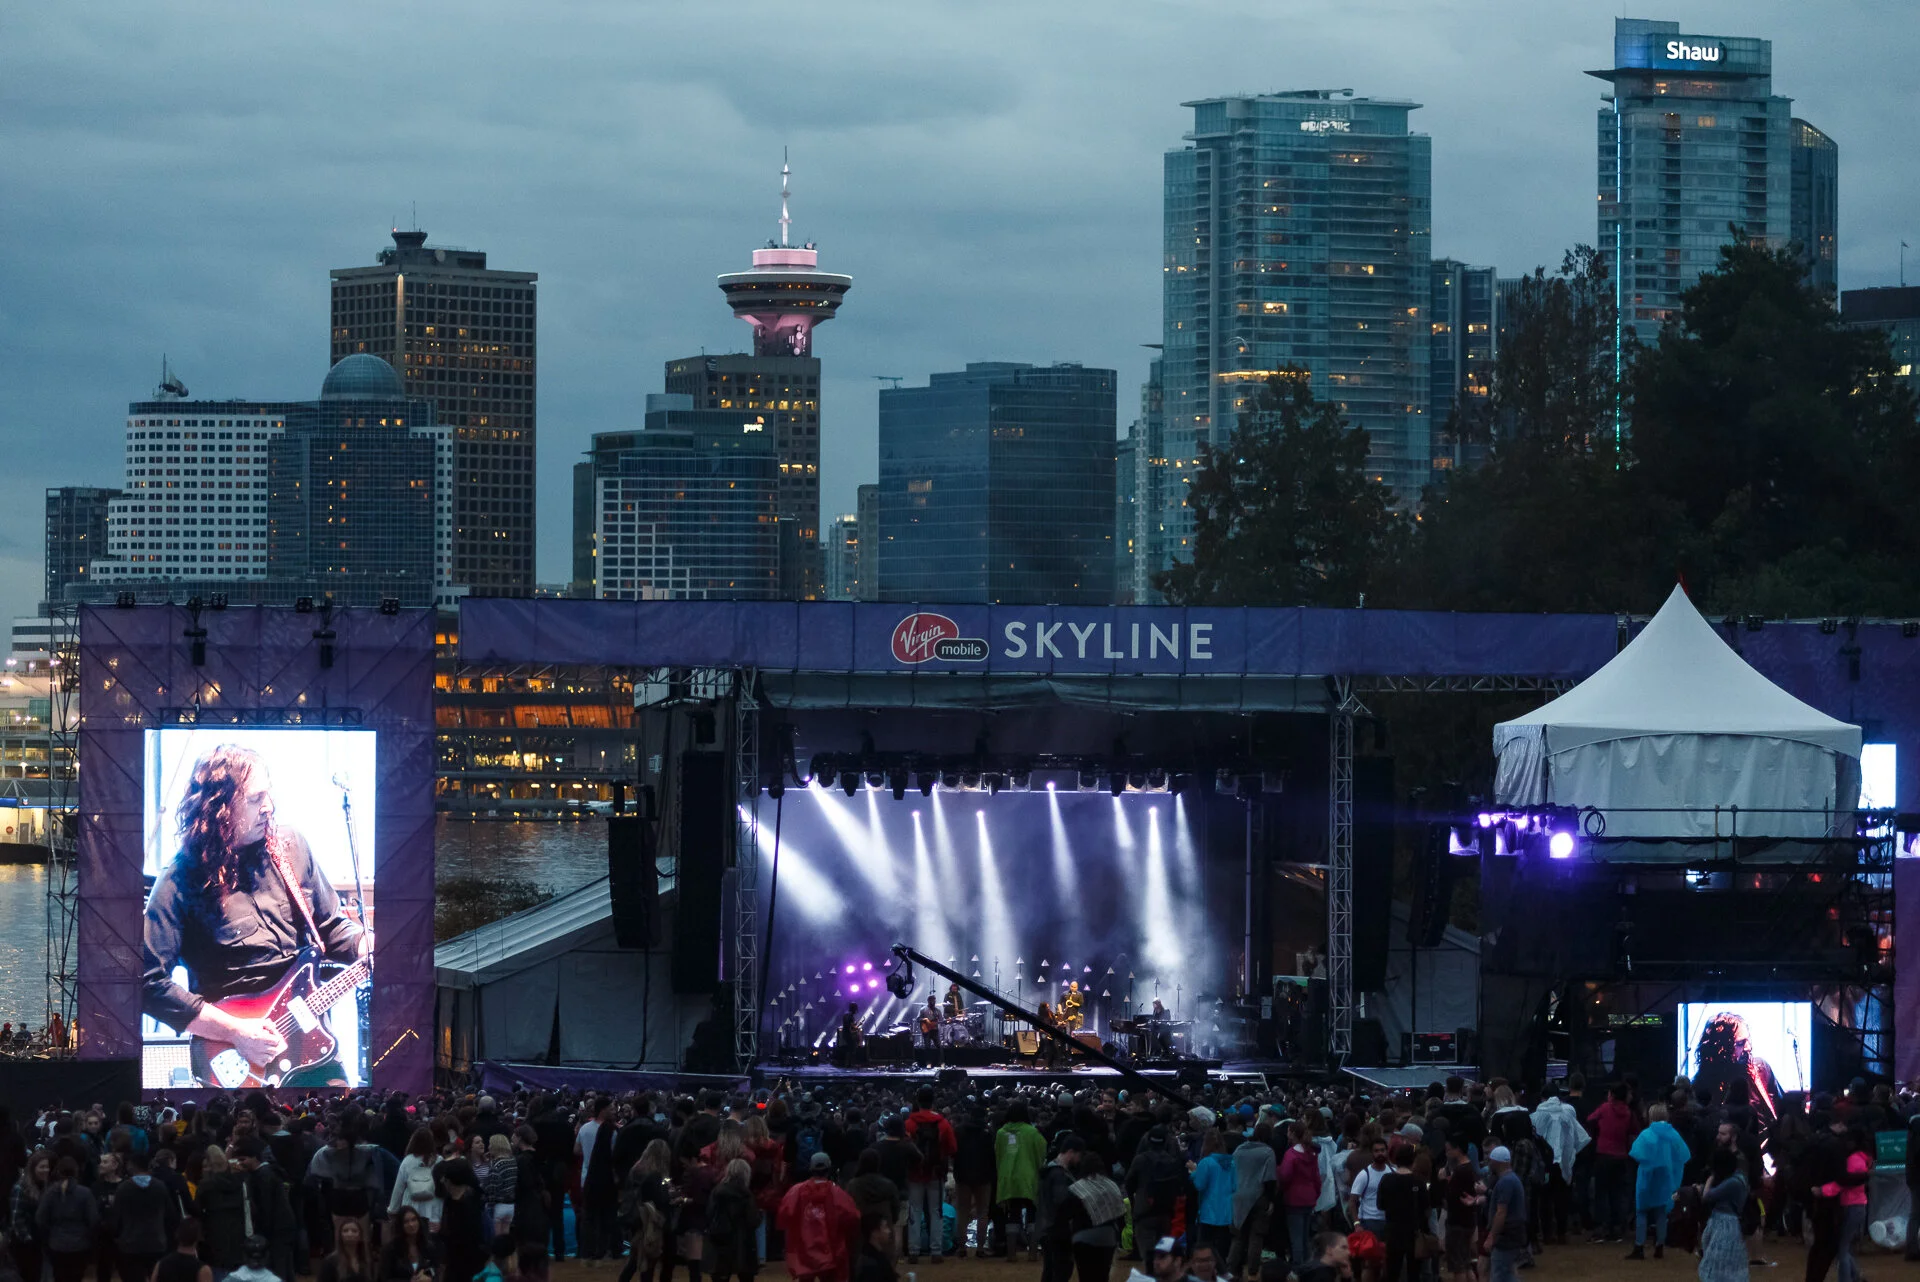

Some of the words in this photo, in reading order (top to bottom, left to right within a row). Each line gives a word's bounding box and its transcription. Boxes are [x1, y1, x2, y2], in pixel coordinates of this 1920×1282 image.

[1666, 41, 1719, 61] Shaw
[743, 423, 763, 433] pwc
[900, 616, 945, 658] Virgin
[941, 643, 981, 656] mobile
[1004, 621, 1213, 660] SKYLINE
